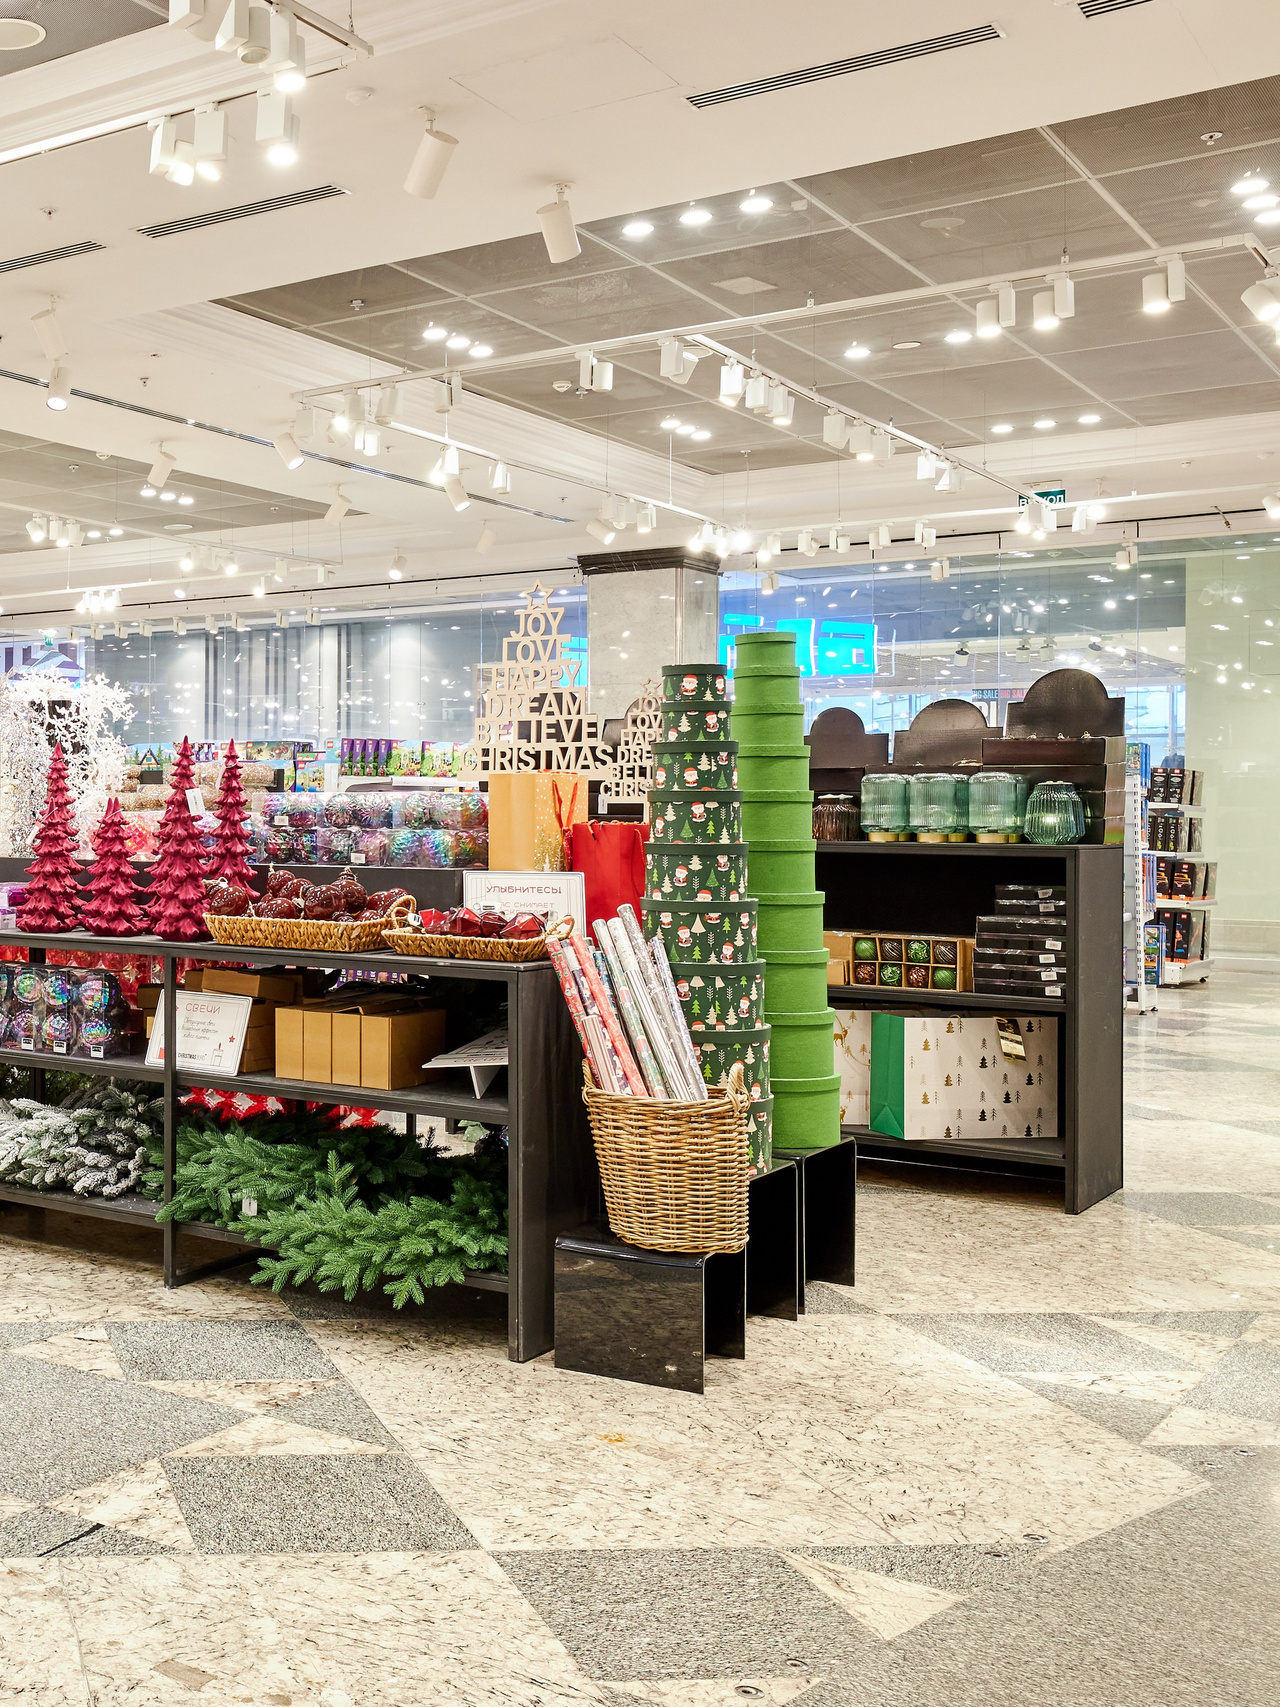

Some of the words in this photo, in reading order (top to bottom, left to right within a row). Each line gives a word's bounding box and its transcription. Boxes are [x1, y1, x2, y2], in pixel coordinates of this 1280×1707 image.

[1019, 494, 1065, 507] ВОД
[510, 607, 565, 638] JOY
[503, 634, 571, 664] LOVE
[492, 661, 582, 690] HAPPY
[983, 689, 998, 699] SALE
[1001, 689, 1010, 698] BIG
[488, 688, 586, 717] DREAM
[627, 712, 662, 730] LOV
[475, 715, 599, 745] BELIEVE
[621, 729, 662, 746] HAP
[460, 742, 614, 772] CHRISTMAS
[617, 746, 652, 764] DRE
[612, 764, 653, 780] BELI
[600, 781, 653, 797] CHRIS
[486, 886, 562, 894] УЛЫБНИТЕСЬ!
[514, 901, 555, 909] СНИМАЕТ
[185, 1003, 221, 1014] СВЕЧИ
